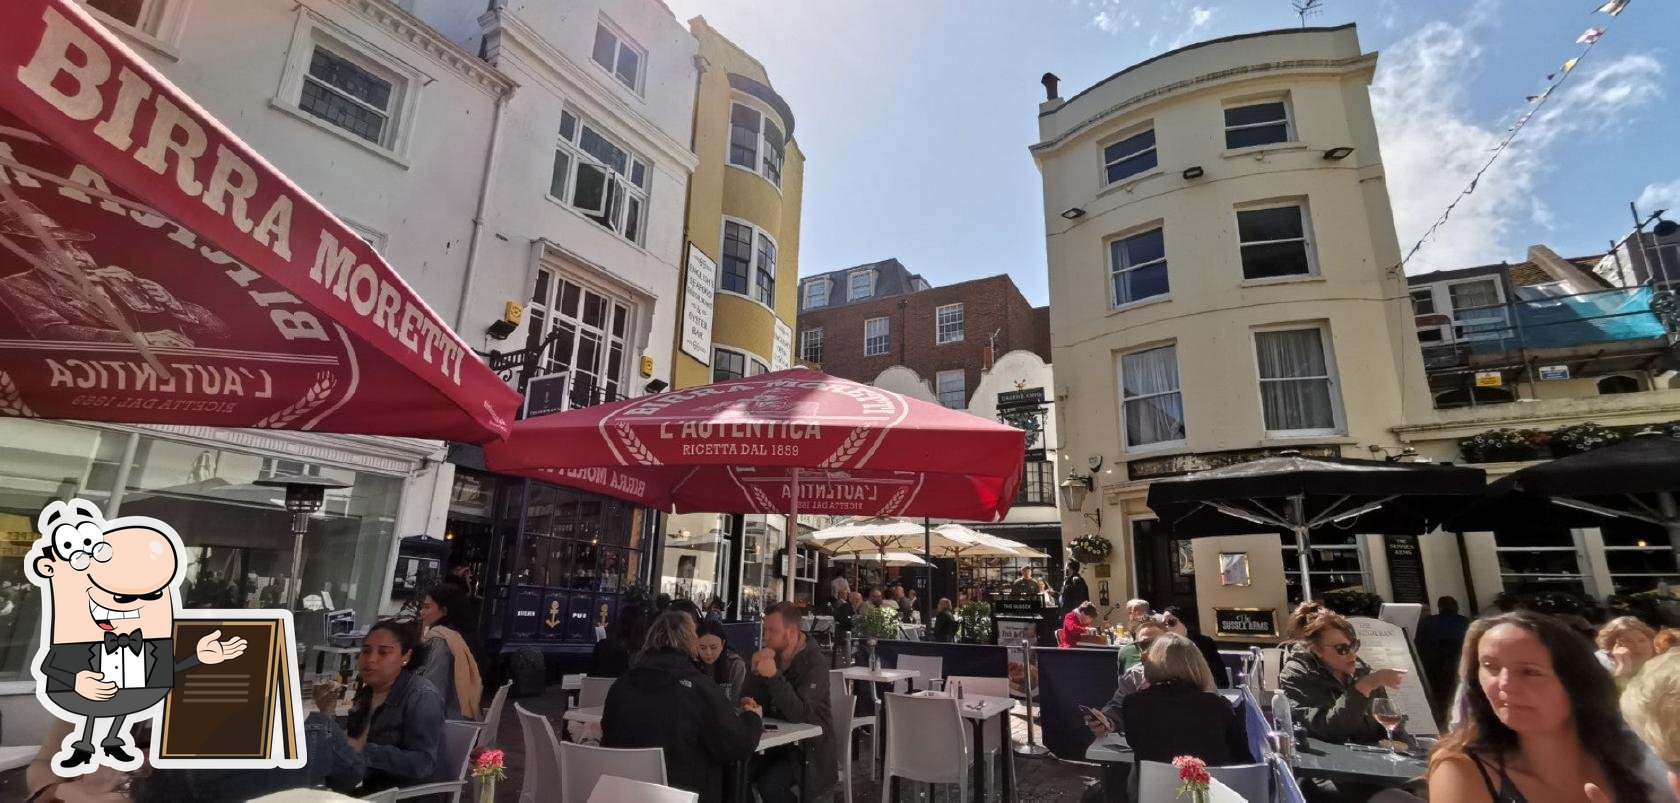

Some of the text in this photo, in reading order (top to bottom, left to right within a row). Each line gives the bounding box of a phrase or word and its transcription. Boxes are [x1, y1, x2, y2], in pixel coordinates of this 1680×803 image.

[17, 5, 465, 386] BIRRA MORETTI
[622, 379, 896, 415] BIRRA MORETTI
[683, 444, 799, 457] RICETTA DAL 1859
[1236, 614, 1250, 623] The
[1222, 621, 1269, 630] SUSSEX ARMS
